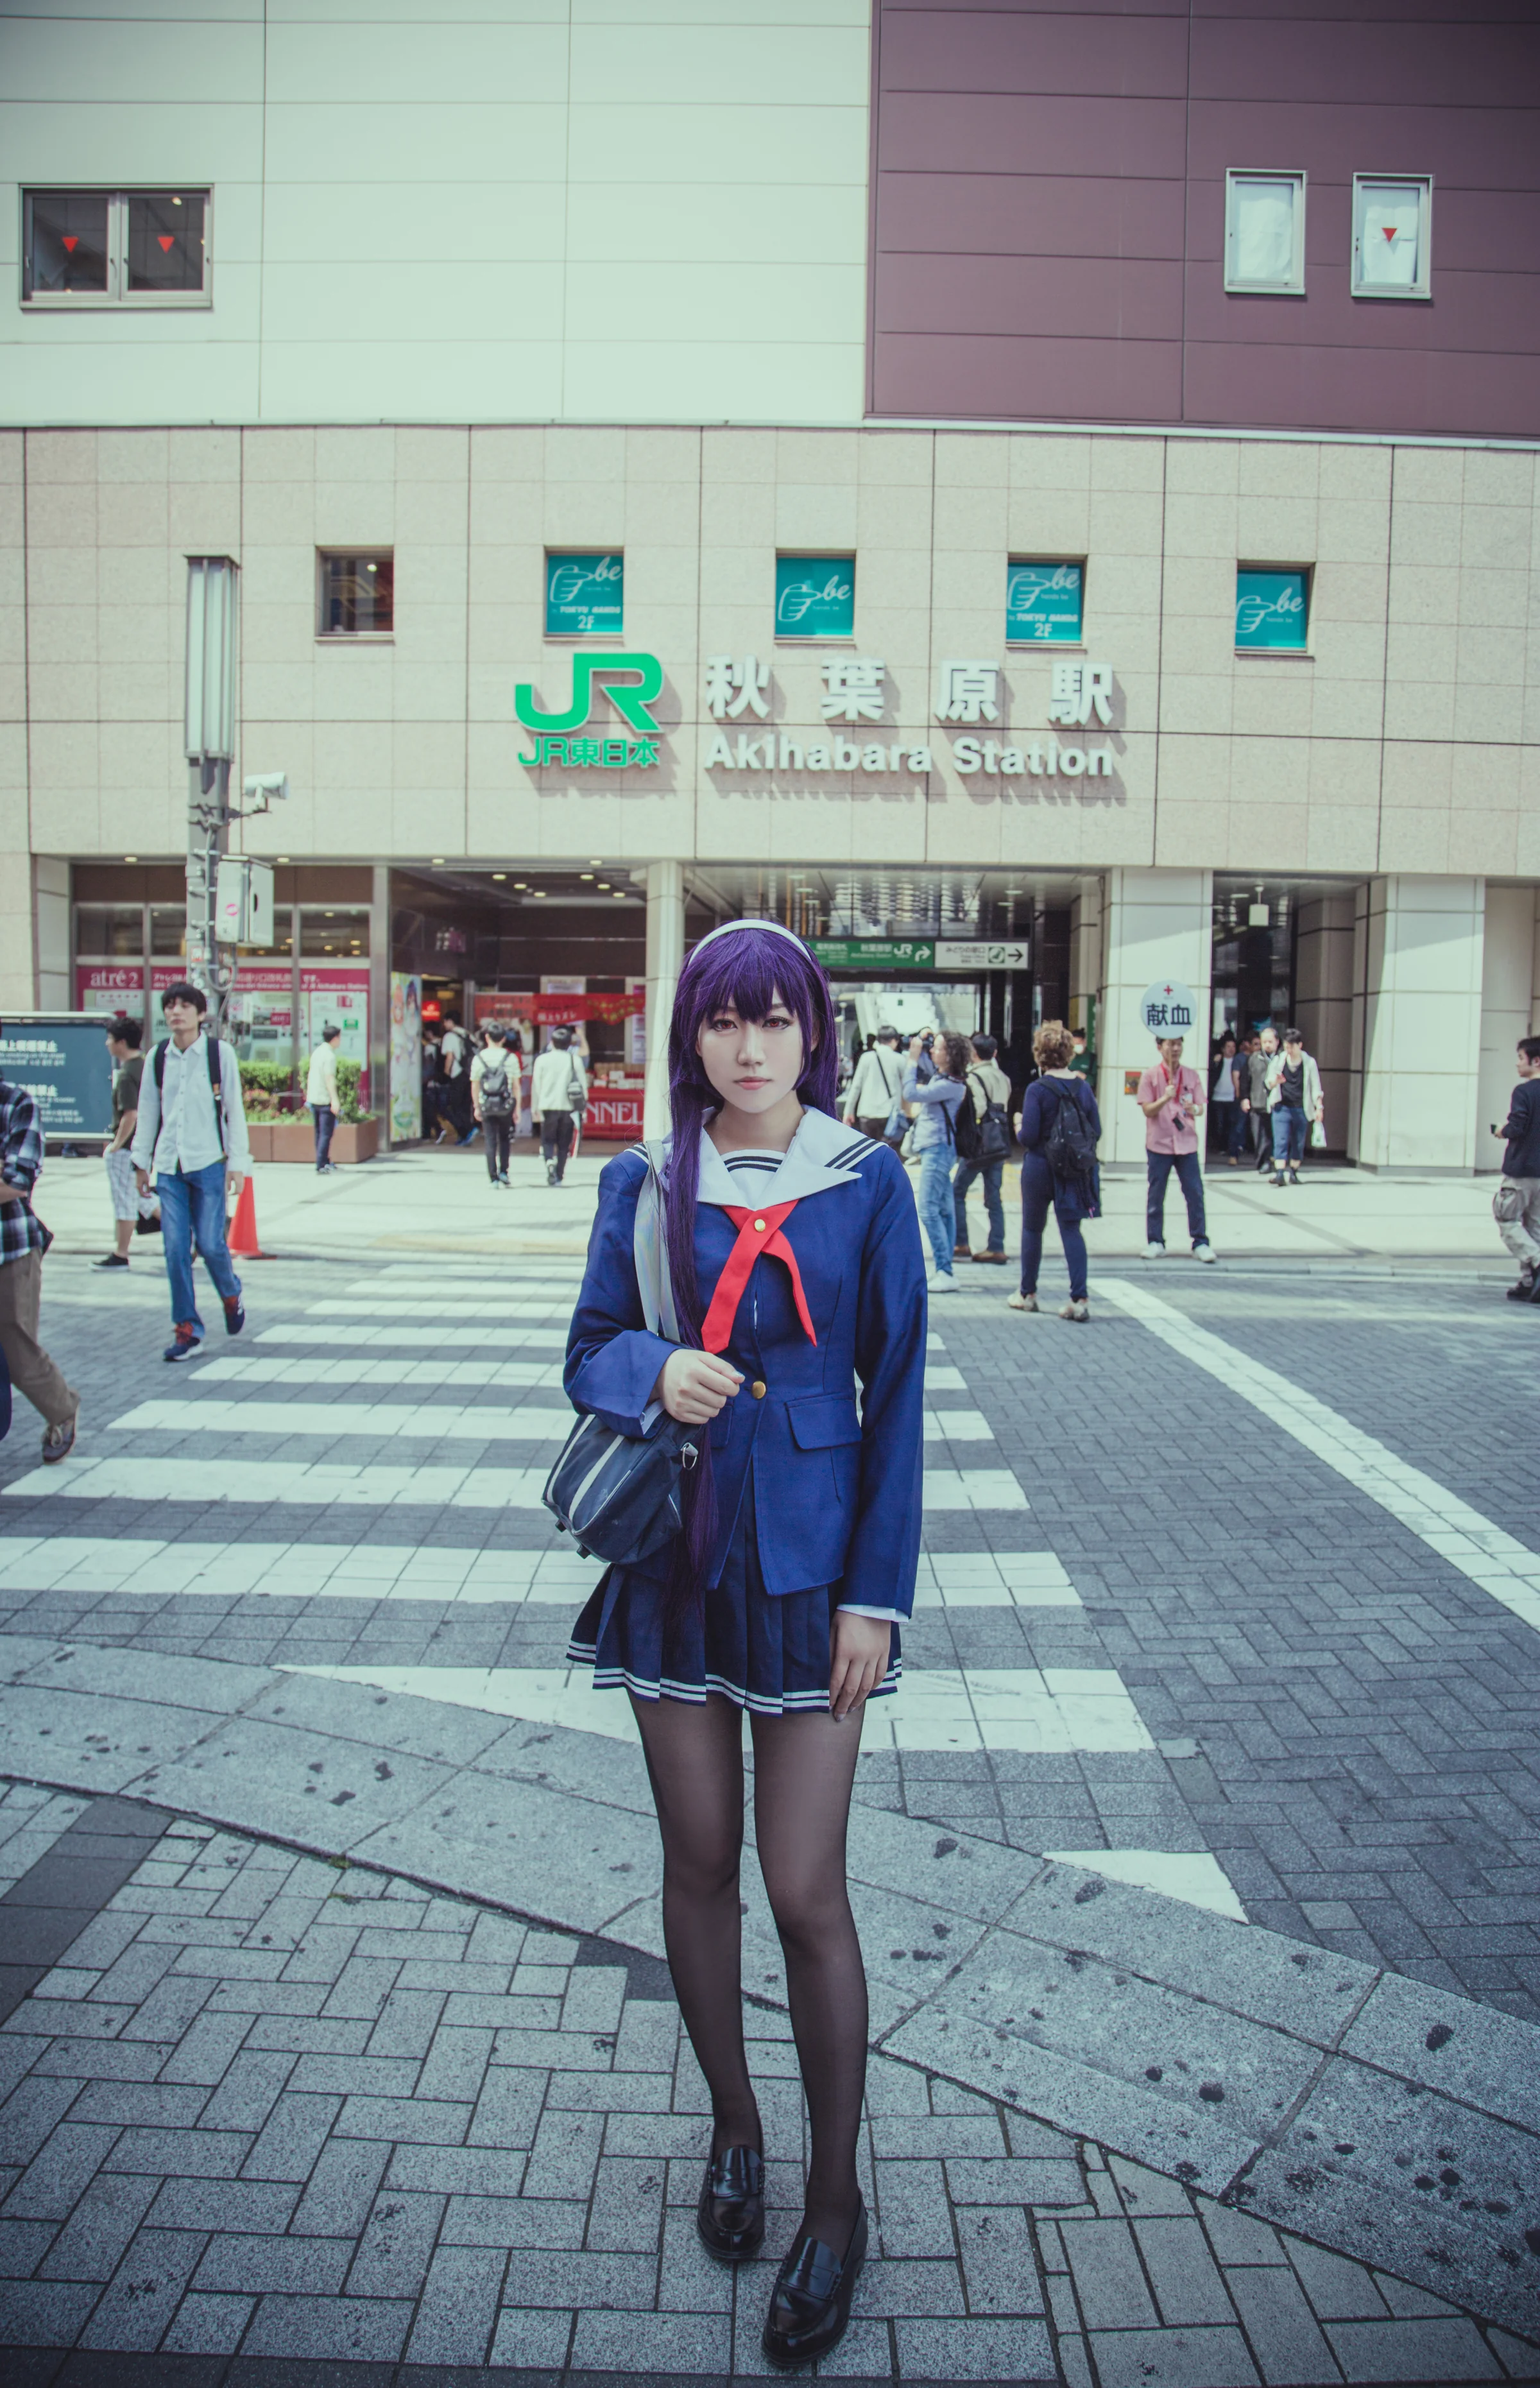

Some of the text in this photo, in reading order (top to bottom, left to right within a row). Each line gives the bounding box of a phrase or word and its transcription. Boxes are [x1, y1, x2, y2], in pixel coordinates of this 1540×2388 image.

[578, 615, 595, 630] 2F
[1034, 623, 1052, 637] 2F
[514, 653, 663, 732] JR
[705, 655, 1113, 725] 秋葉原駅
[517, 737, 660, 768] JR東日本
[704, 732, 1113, 776] Akihabara Station
[893, 943, 913, 955] JR
[90, 969, 139, 988] atré 2
[1146, 1002, 1192, 1026] 献血
